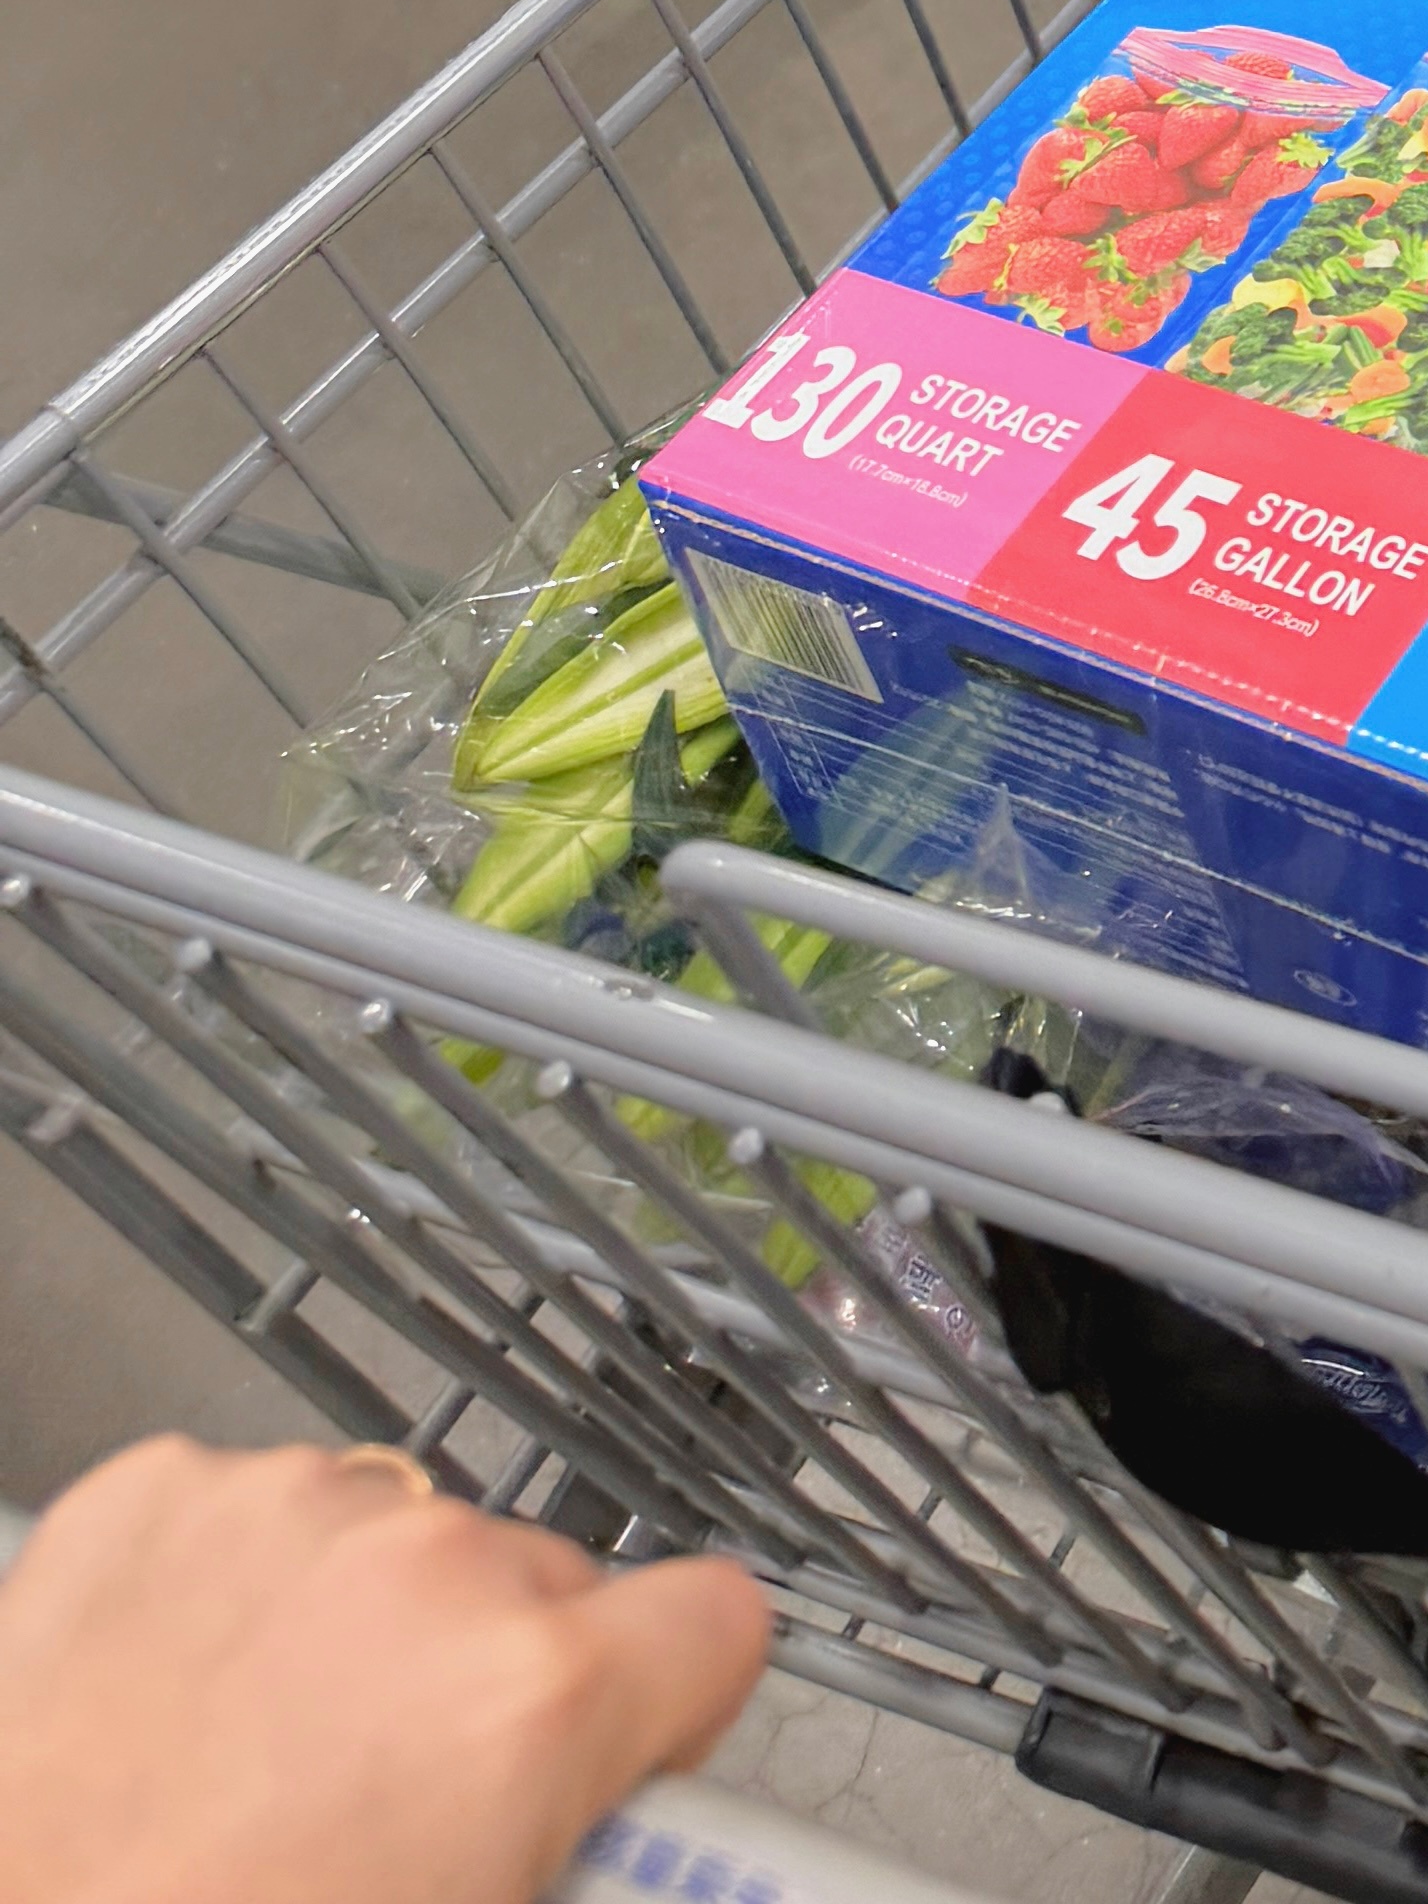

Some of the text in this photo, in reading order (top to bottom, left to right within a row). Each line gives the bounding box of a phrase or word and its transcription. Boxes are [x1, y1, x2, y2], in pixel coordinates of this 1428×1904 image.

[703, 330, 1082, 460] 130 STORAGE
[875, 414, 1004, 477] QUART
[1062, 452, 1244, 581] 45
[1214, 536, 1376, 616] GALLON
